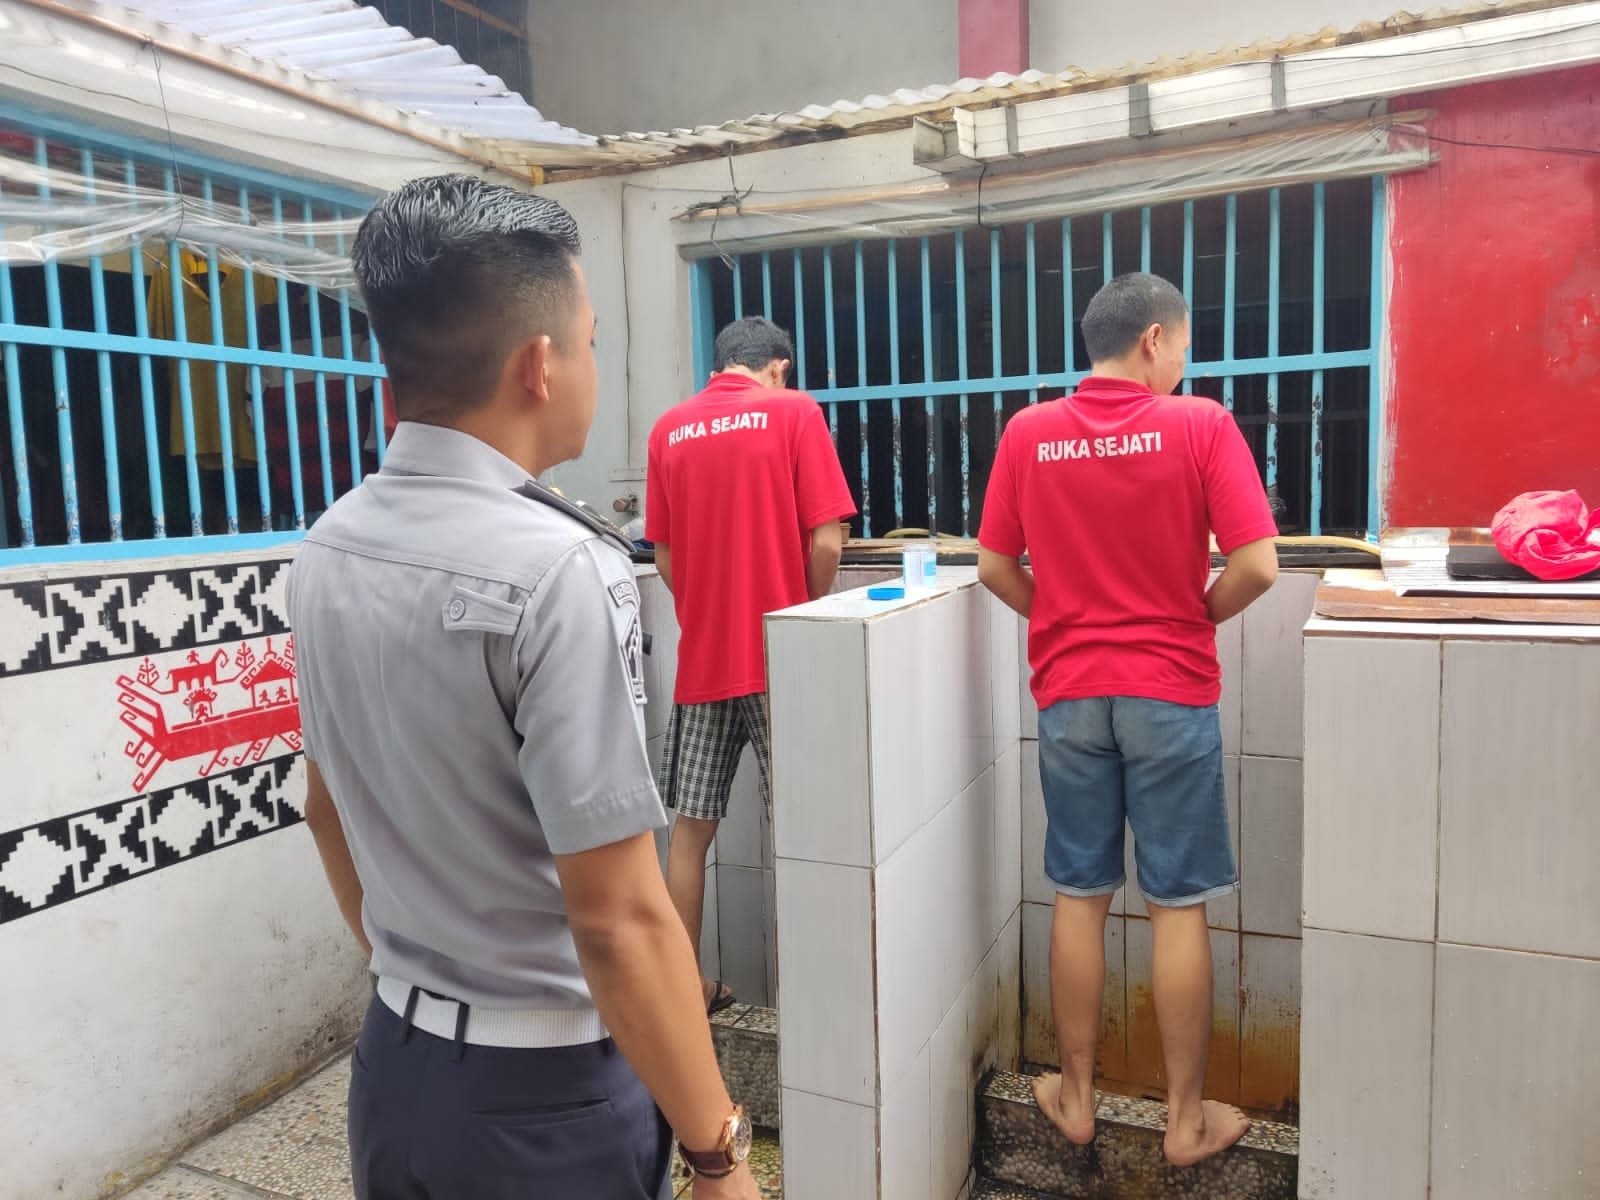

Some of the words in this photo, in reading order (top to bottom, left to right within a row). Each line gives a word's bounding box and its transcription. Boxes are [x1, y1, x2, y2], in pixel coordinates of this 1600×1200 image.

[668, 422, 707, 447] RUKA
[710, 412, 769, 435] SEJATI
[1037, 438, 1091, 462] RUKA
[1094, 431, 1163, 457] SEJATI
